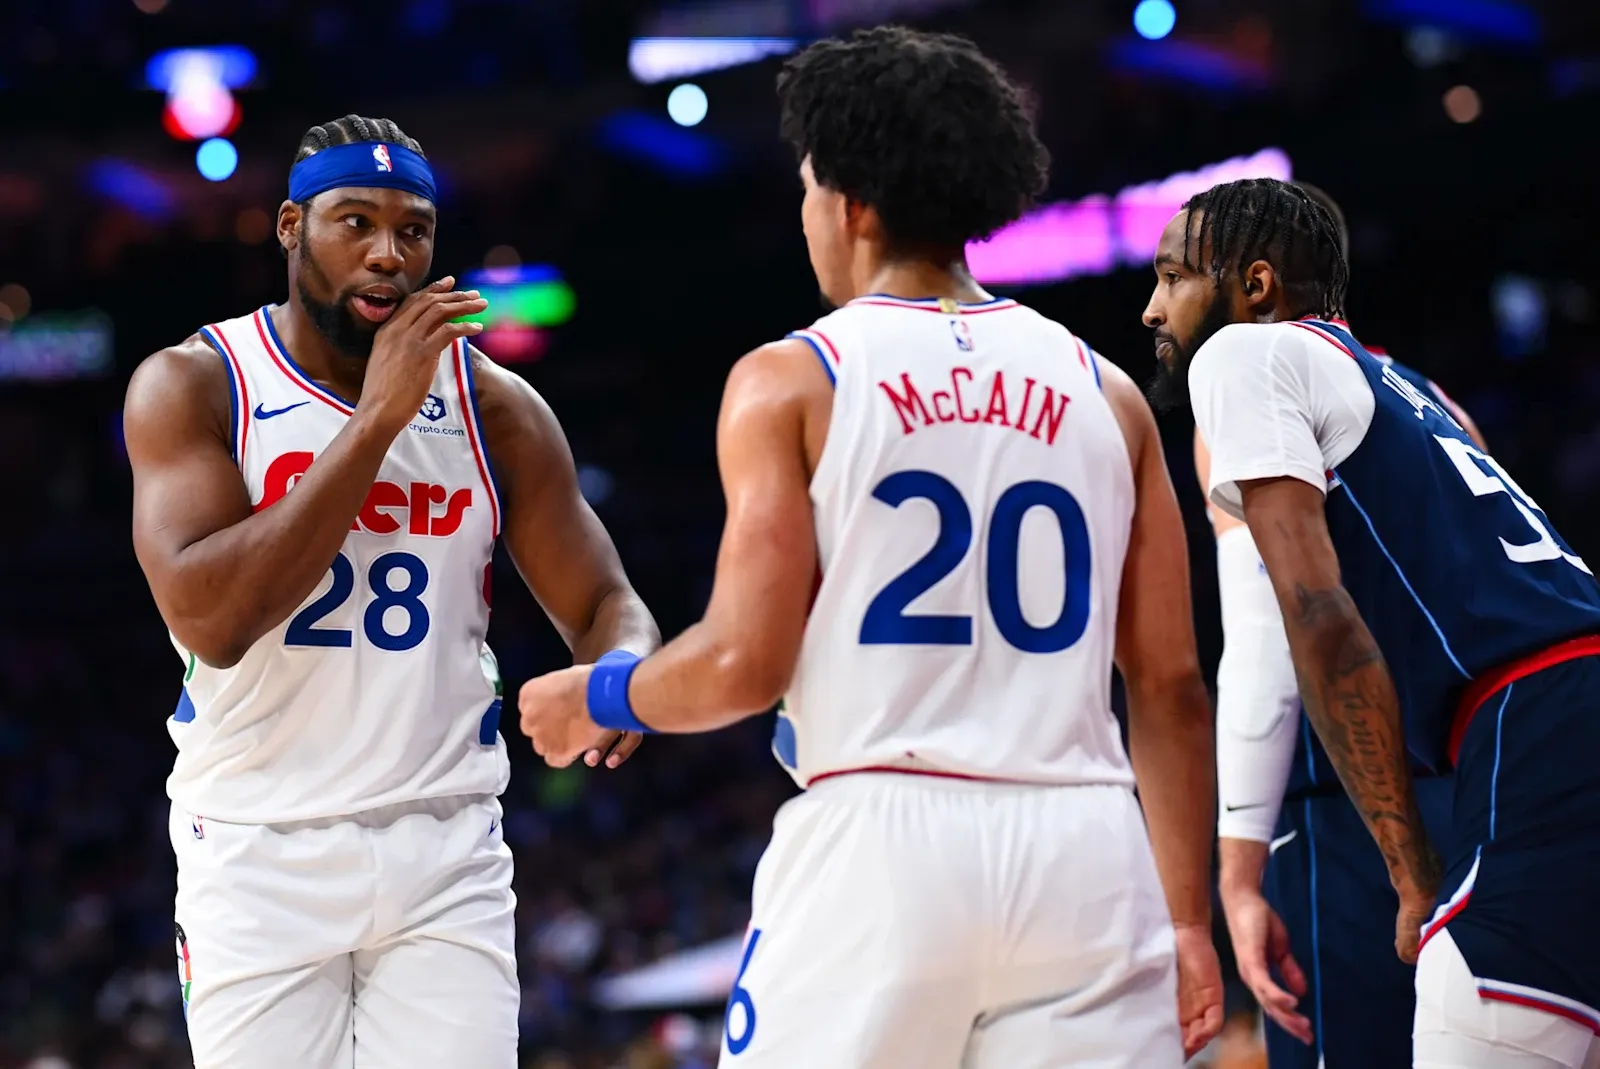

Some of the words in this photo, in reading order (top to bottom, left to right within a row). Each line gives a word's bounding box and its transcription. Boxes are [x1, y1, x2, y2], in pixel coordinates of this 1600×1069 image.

[408, 423, 465, 436] crypto.com
[878, 367, 1071, 446] McCAIN
[252, 451, 472, 537] Sers
[284, 551, 430, 651] 28
[858, 469, 1092, 654] 20
